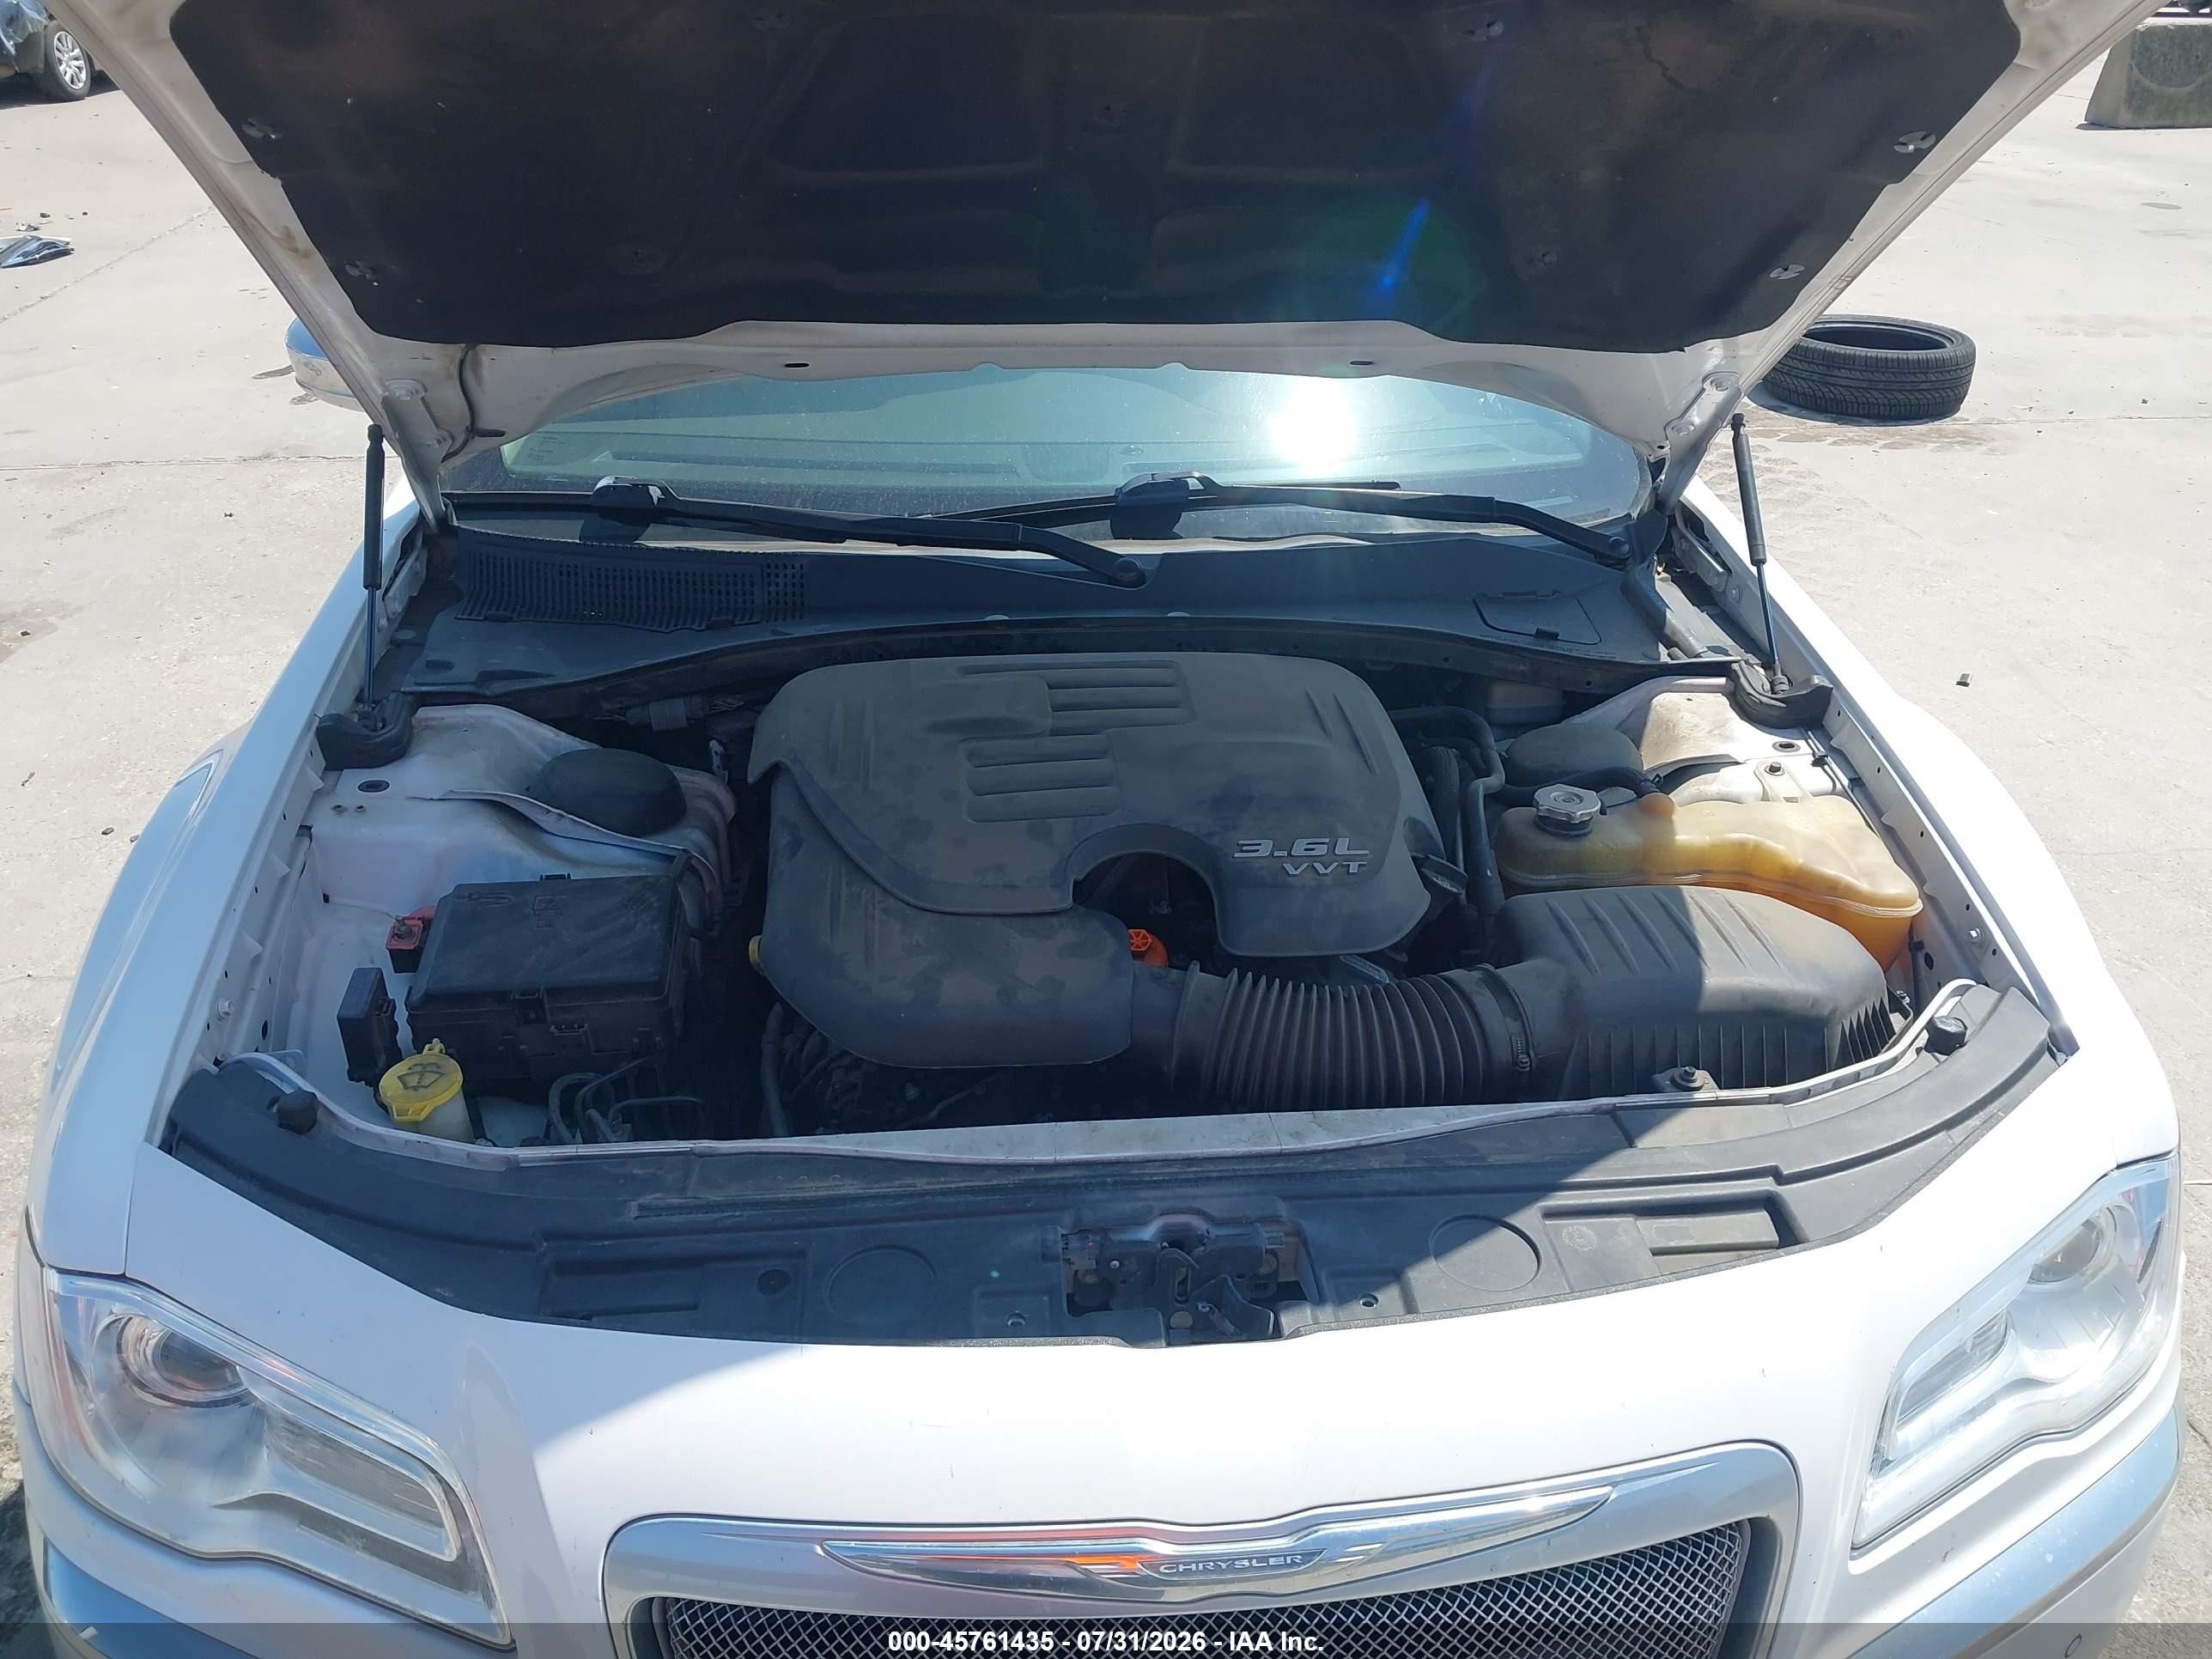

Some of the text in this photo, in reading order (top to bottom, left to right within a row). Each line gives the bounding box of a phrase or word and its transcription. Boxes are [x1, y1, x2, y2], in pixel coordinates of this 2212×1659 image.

[1234, 838, 1370, 858] 3.6L
[1283, 861, 1368, 875] VVT
[1158, 1555, 1304, 1574] CHRYSLER
